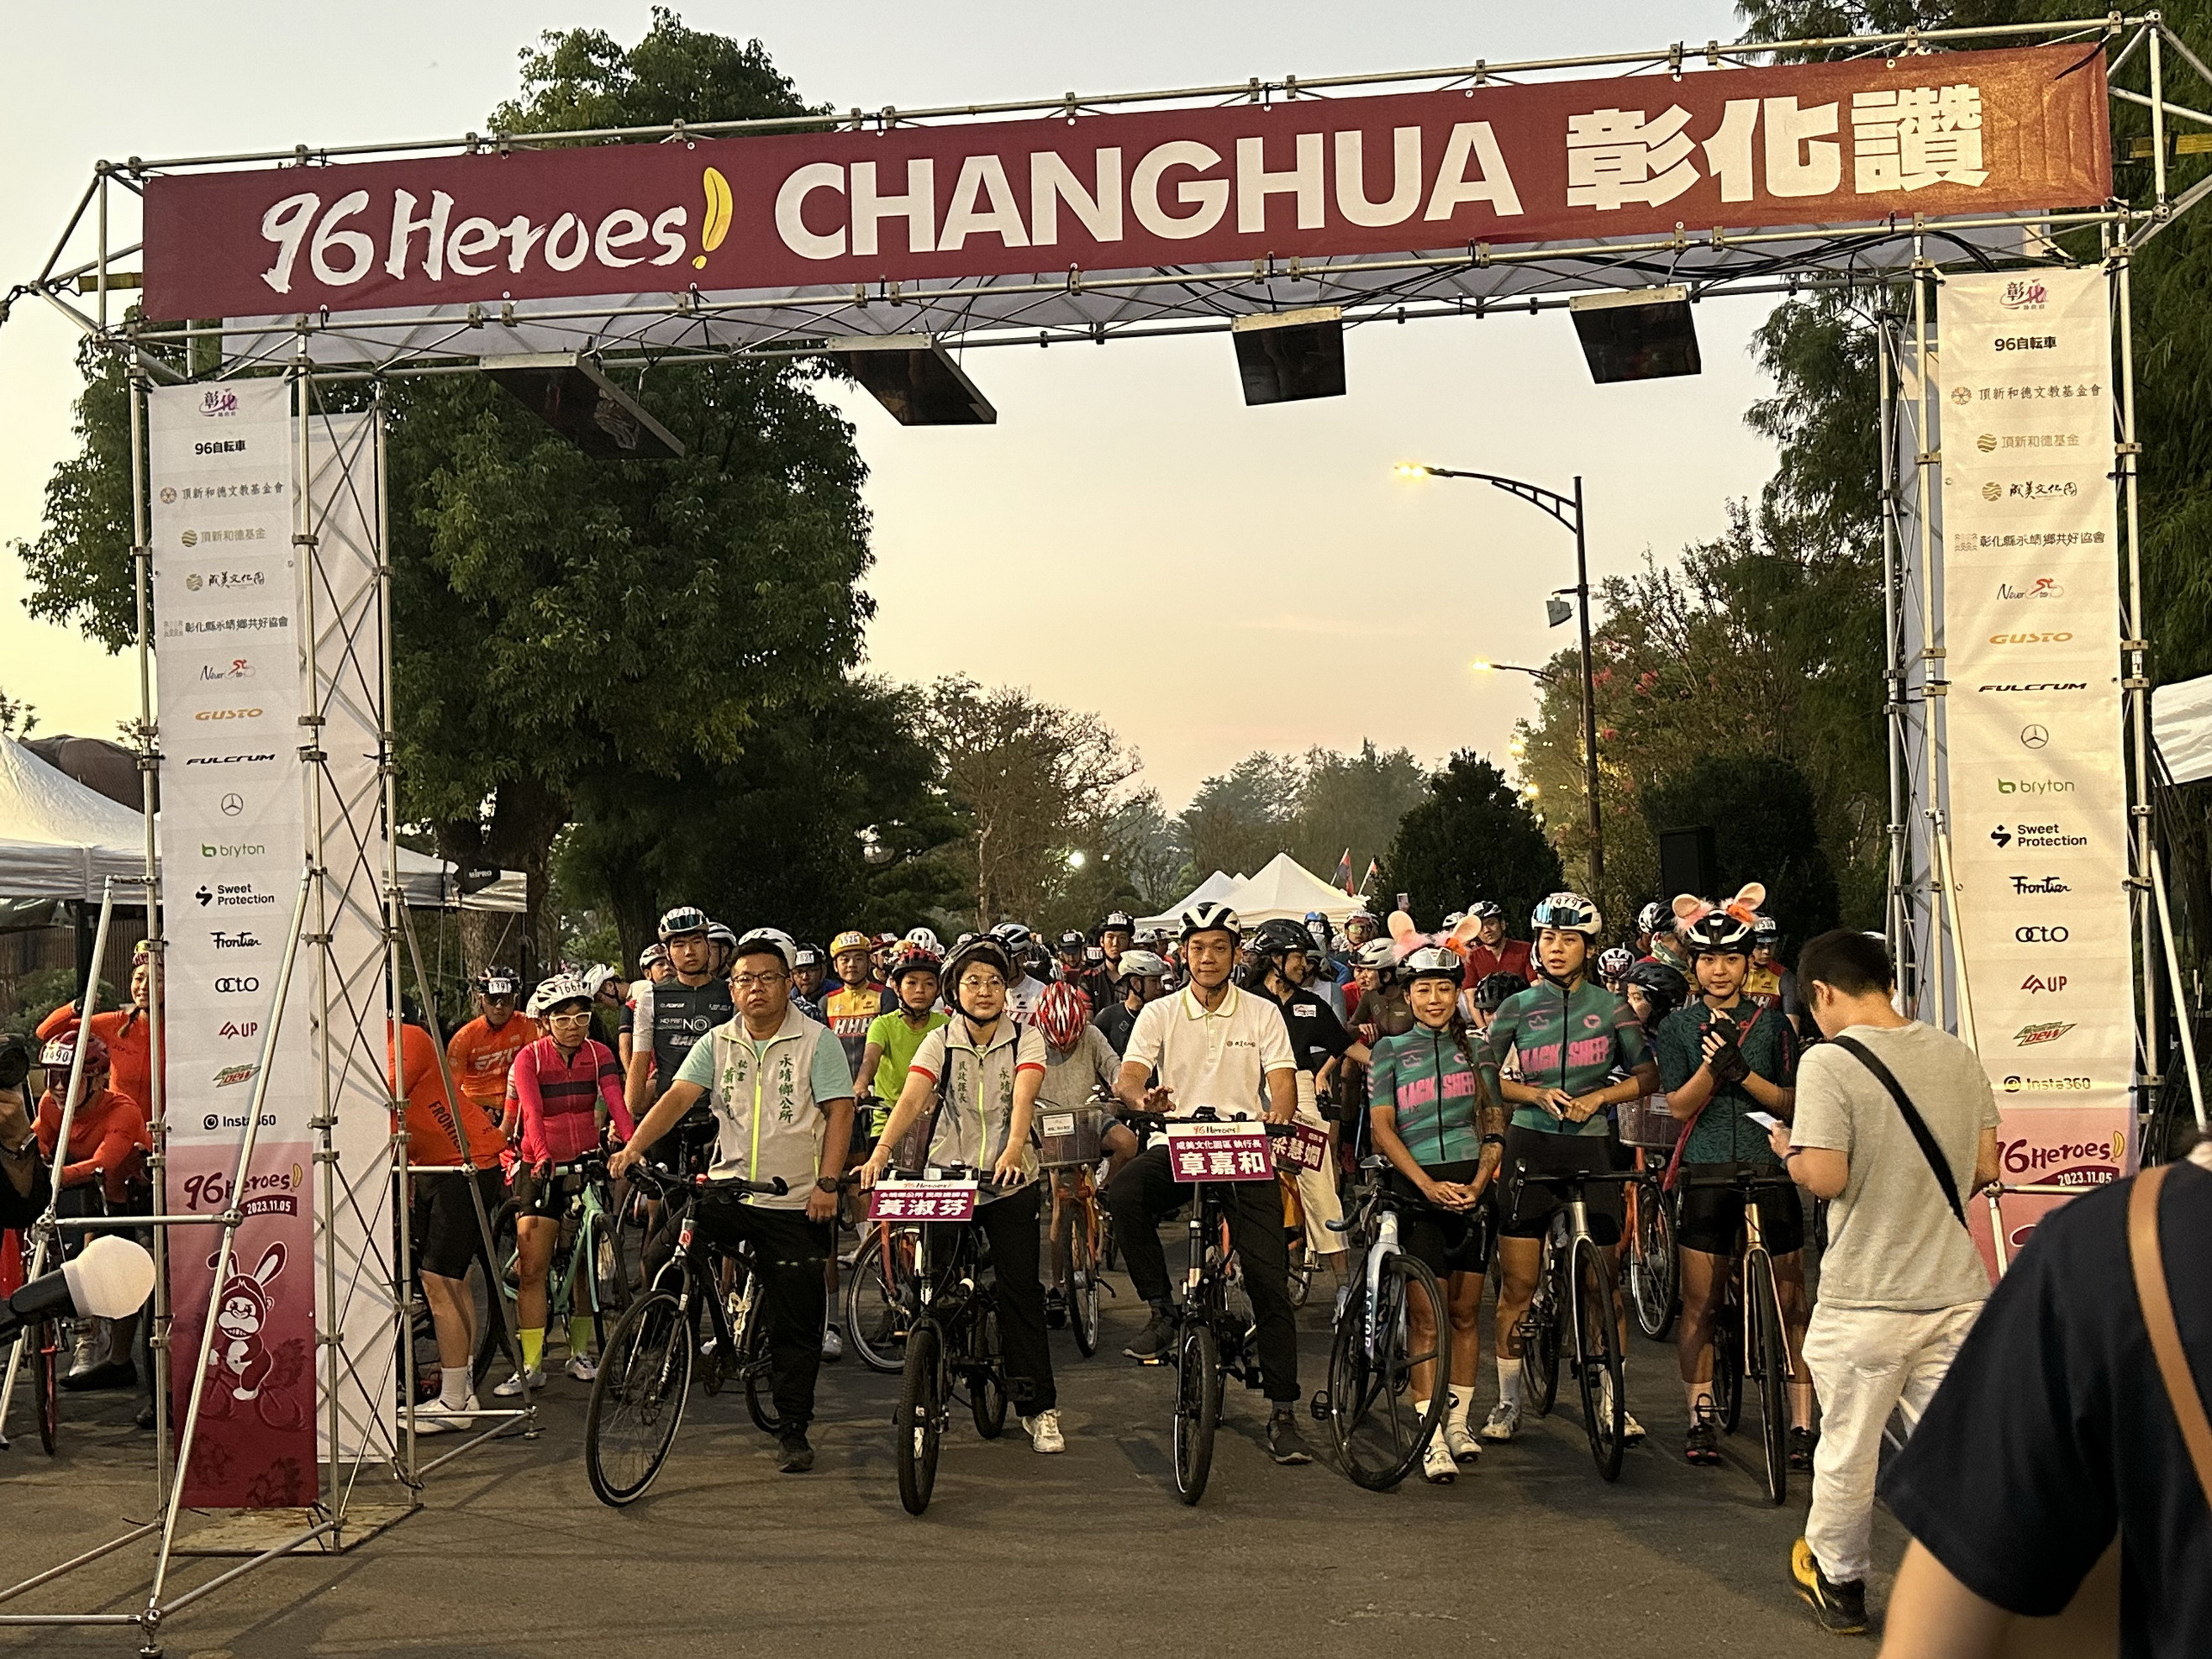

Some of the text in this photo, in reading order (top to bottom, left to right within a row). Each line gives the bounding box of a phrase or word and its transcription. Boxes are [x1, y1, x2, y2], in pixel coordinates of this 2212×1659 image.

[775, 120, 1524, 261] CHANGHUA
[1567, 84, 1990, 210] 彰化讚
[1994, 336, 2057, 351] 96自転車
[194, 440, 246, 455] 96自転車
[1989, 632, 2073, 645] GUSTO
[195, 708, 264, 721] GUSTO
[2020, 779, 2075, 795] bryton
[2017, 824, 2059, 835] Sweet
[2018, 835, 2088, 847] Protection
[219, 843, 266, 858] bryton
[217, 883, 252, 894] Sweet
[2009, 876, 2072, 895] Frontier
[217, 894, 275, 906] Protection
[209, 931, 262, 950] Frontier
[2047, 976, 2067, 992] UP
[241, 1022, 258, 1037] UP
[222, 1114, 276, 1128] Inst60
[1178, 1151, 1267, 1177] 章嘉和
[2057, 1171, 2113, 1187] 2023.11.05
[246, 1200, 292, 1214] 2023.11.05
[876, 1199, 968, 1216] 黃淑芬
